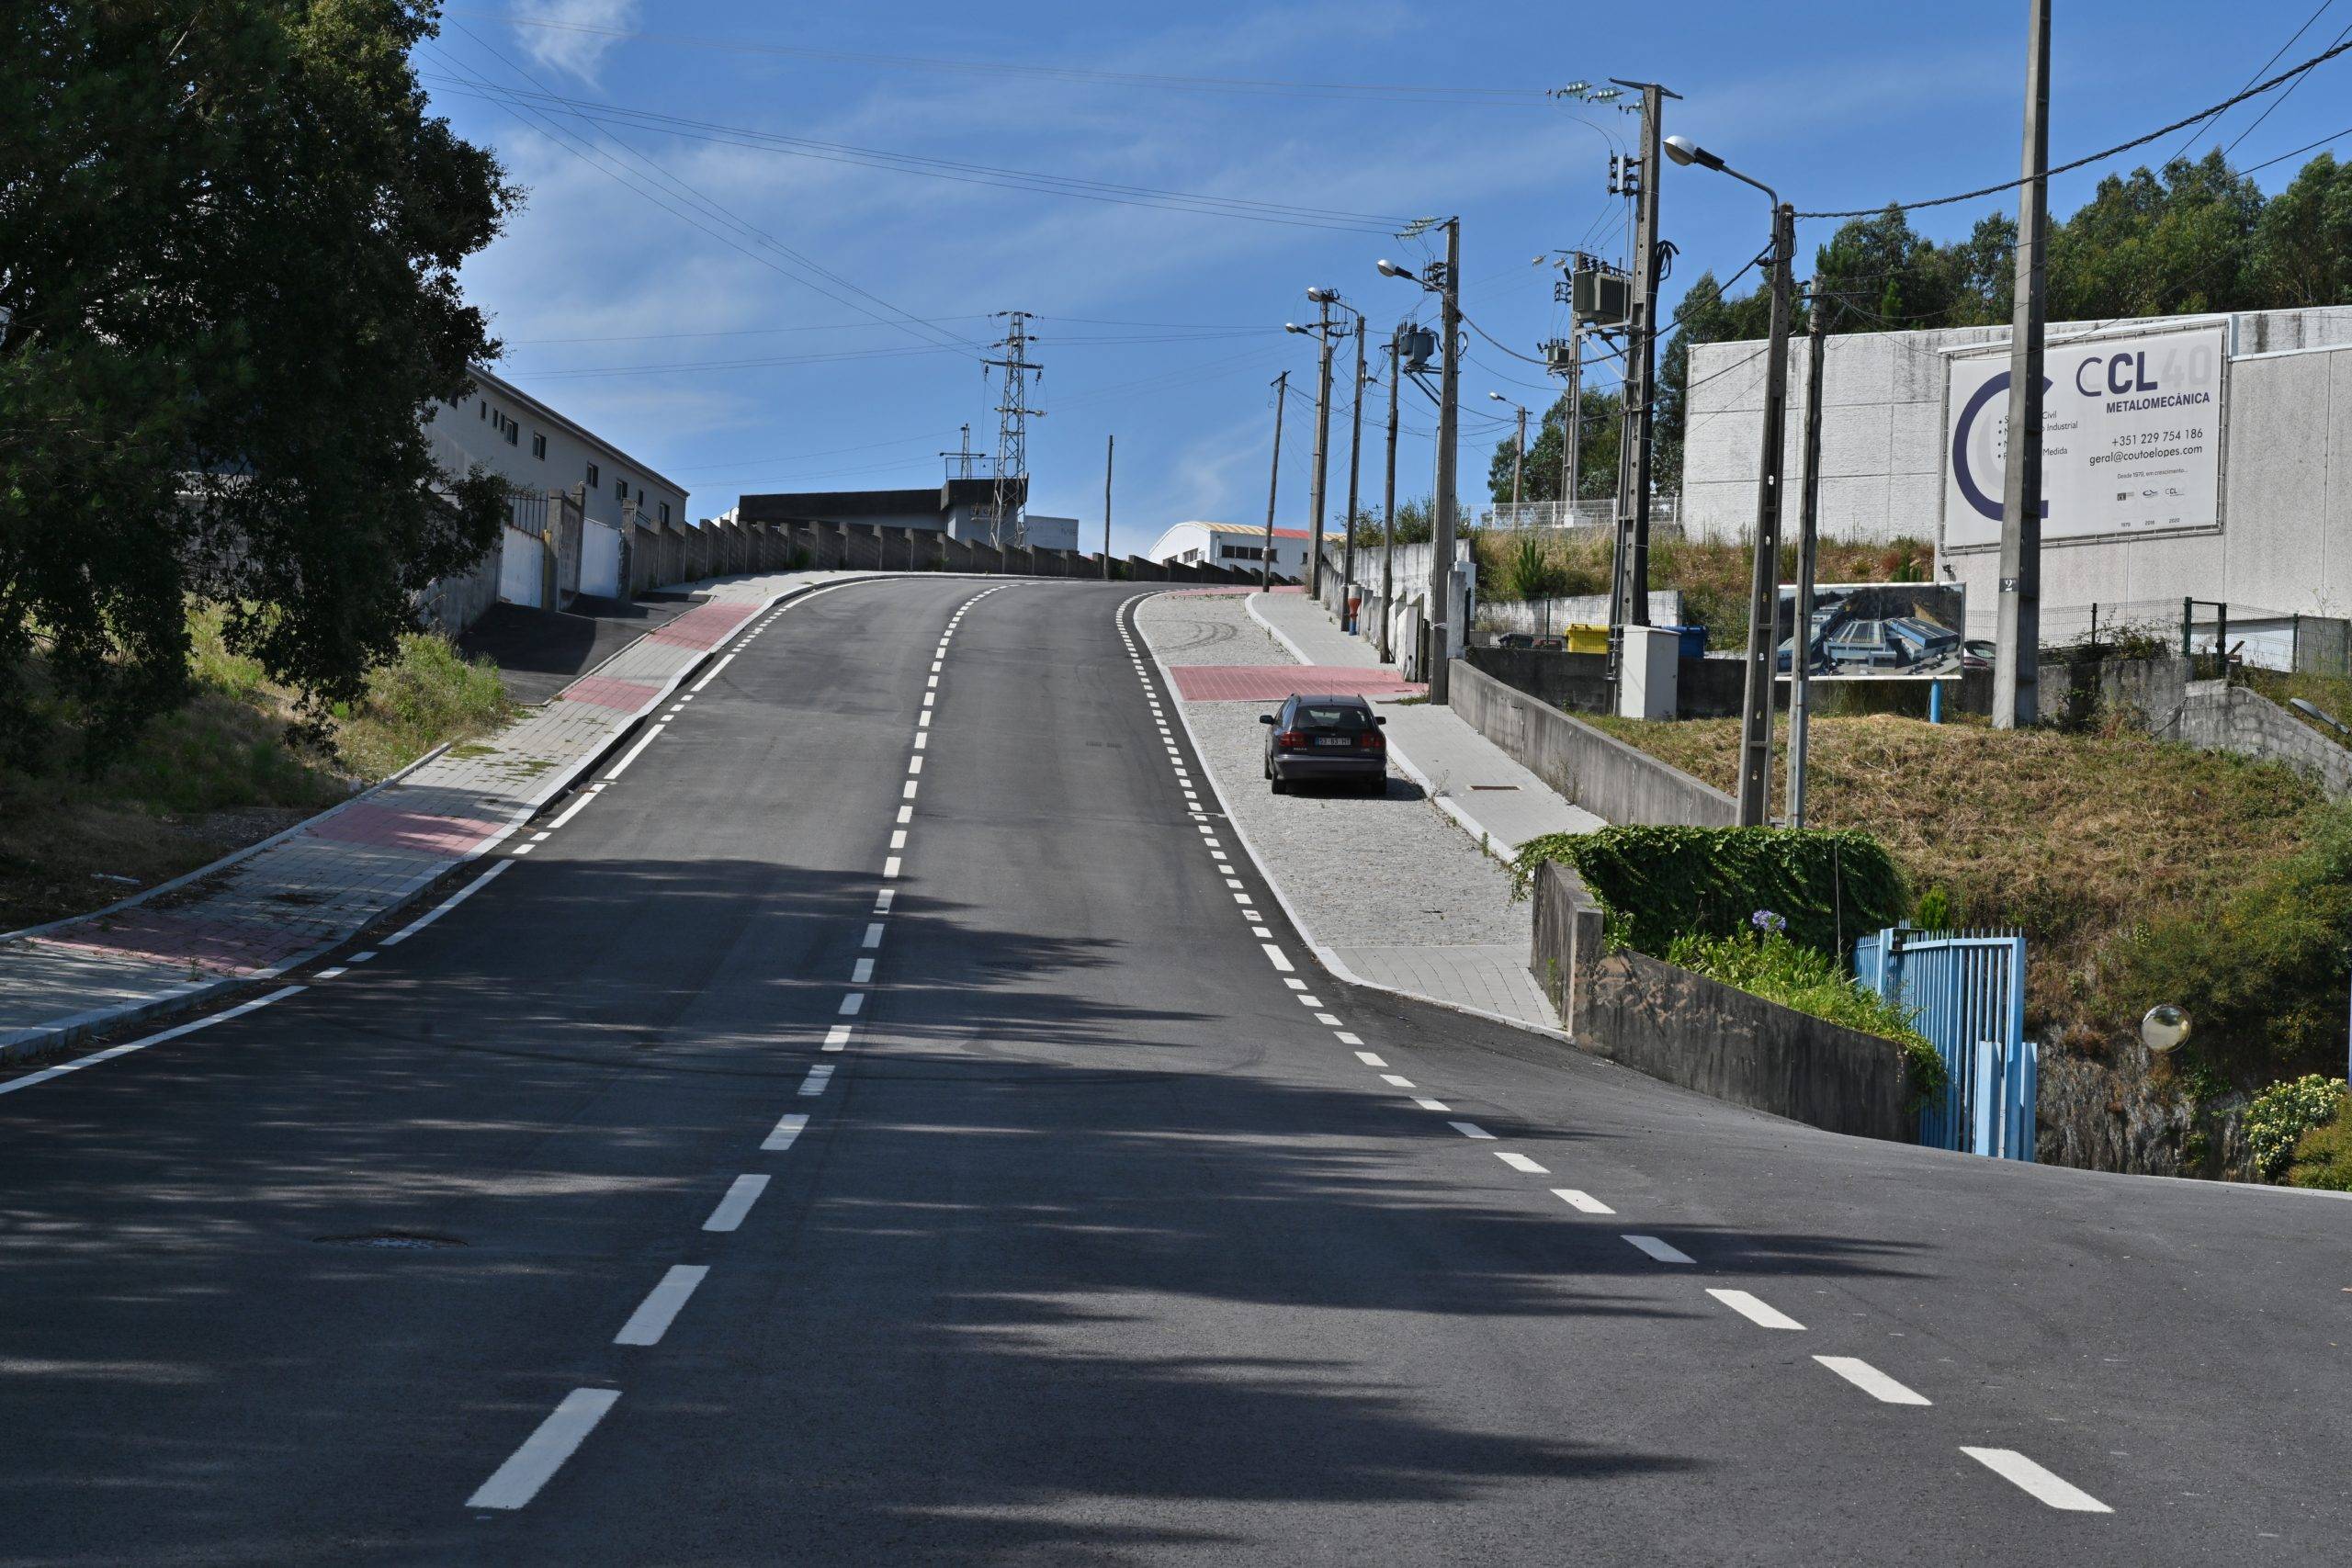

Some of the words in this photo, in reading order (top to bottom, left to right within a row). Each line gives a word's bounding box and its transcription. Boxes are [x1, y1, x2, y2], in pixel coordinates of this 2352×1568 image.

[2106, 392, 2211, 414] METALOMECÂNICA
[2042, 411, 2057, 420] Civil
[2047, 421, 2078, 432] Industrial
[2111, 434, 2136, 447] +351
[2141, 432, 2160, 445] 229
[2163, 430, 2181, 442] 754
[2185, 427, 2203, 440] 186
[2042, 446, 2068, 457] Medida
[2089, 446, 2203, 467] geral@coutoelopes.com
